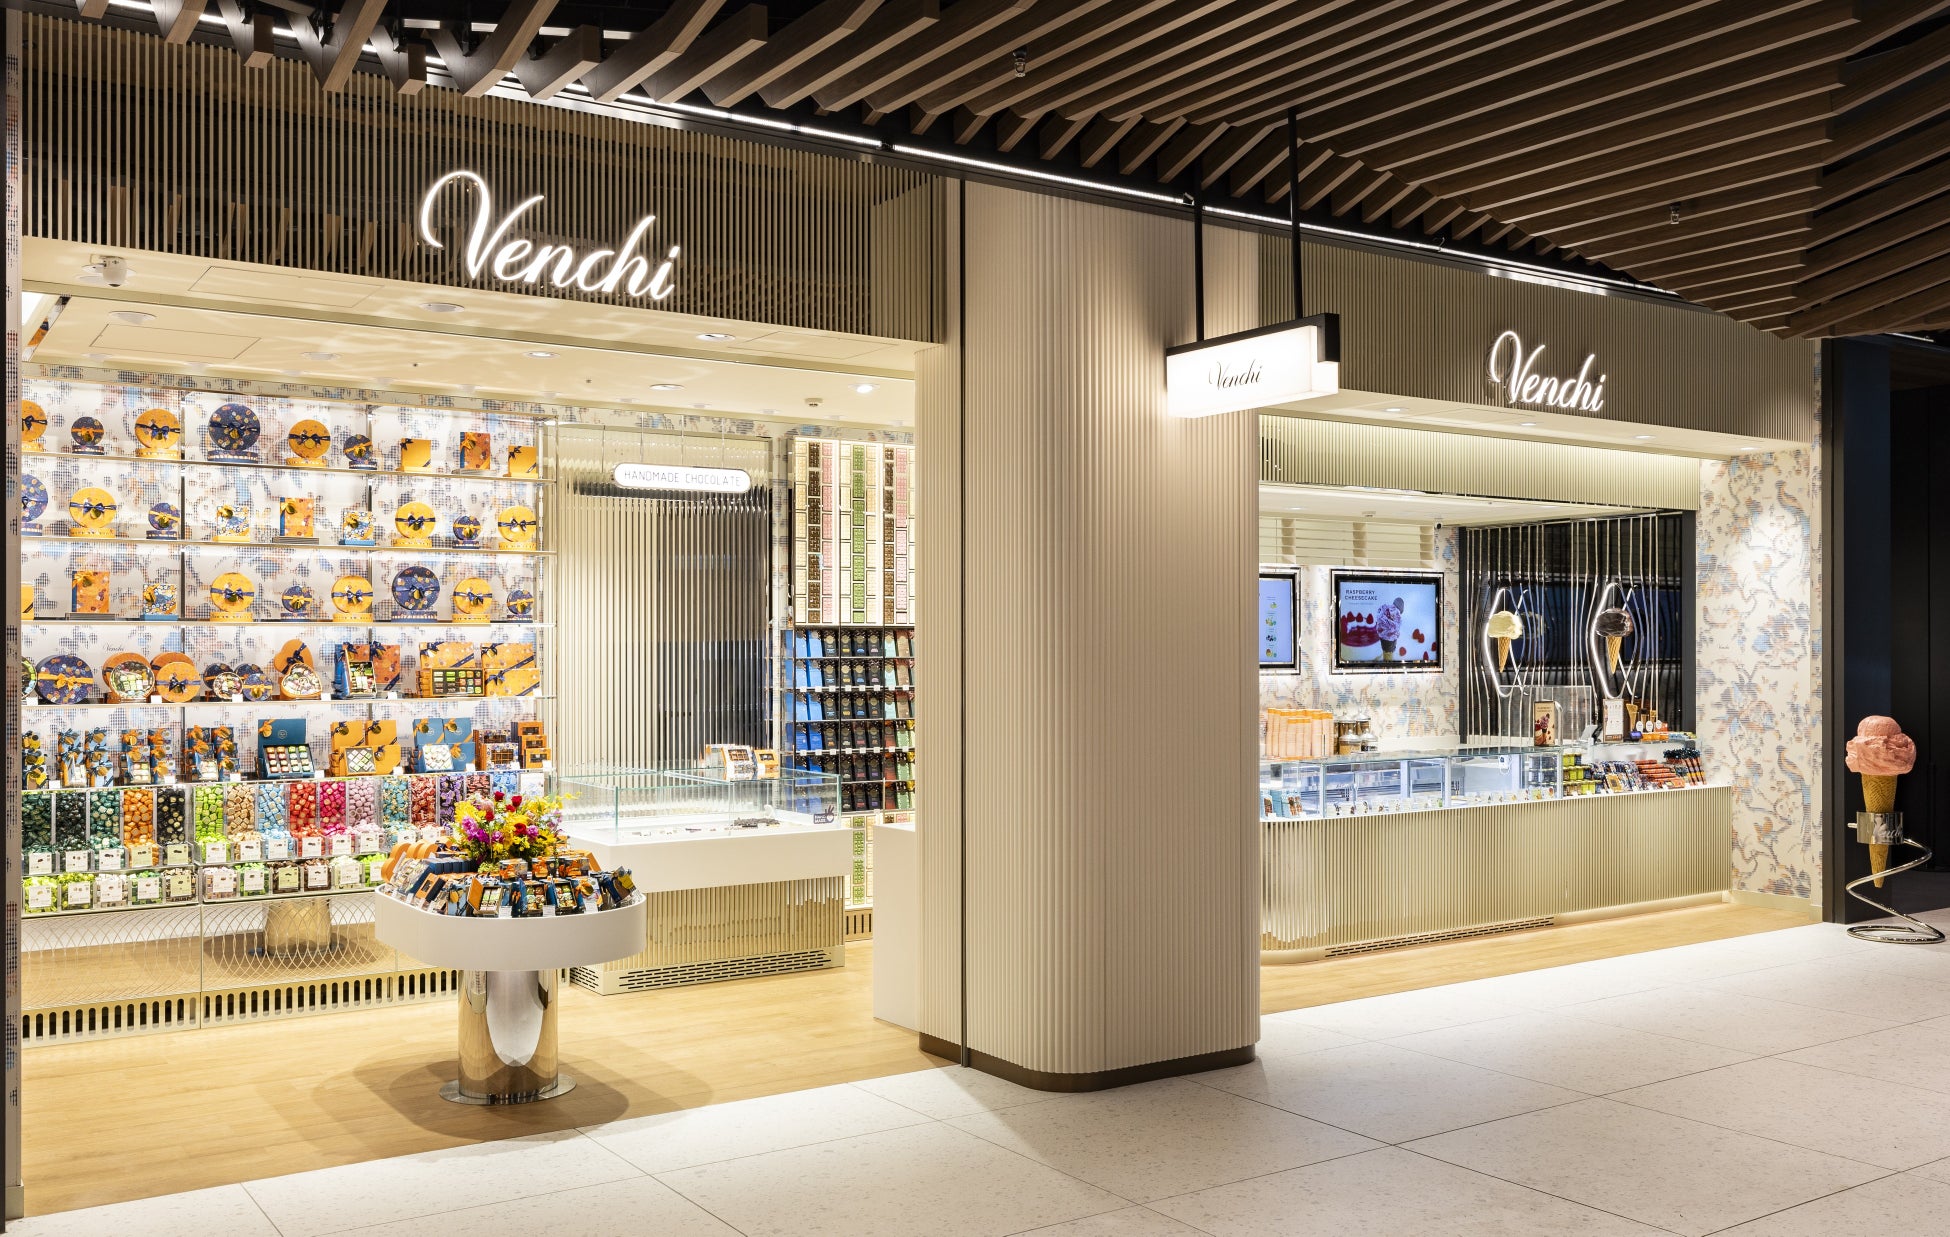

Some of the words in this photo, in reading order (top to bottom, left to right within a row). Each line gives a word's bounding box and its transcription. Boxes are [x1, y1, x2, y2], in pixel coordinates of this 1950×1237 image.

[421, 170, 680, 300] Venchi
[1208, 358, 1263, 391] Venchi
[1490, 330, 1606, 411] Venchi
[624, 470, 680, 483] HANDMADE
[685, 473, 741, 487] CHOCOLATE
